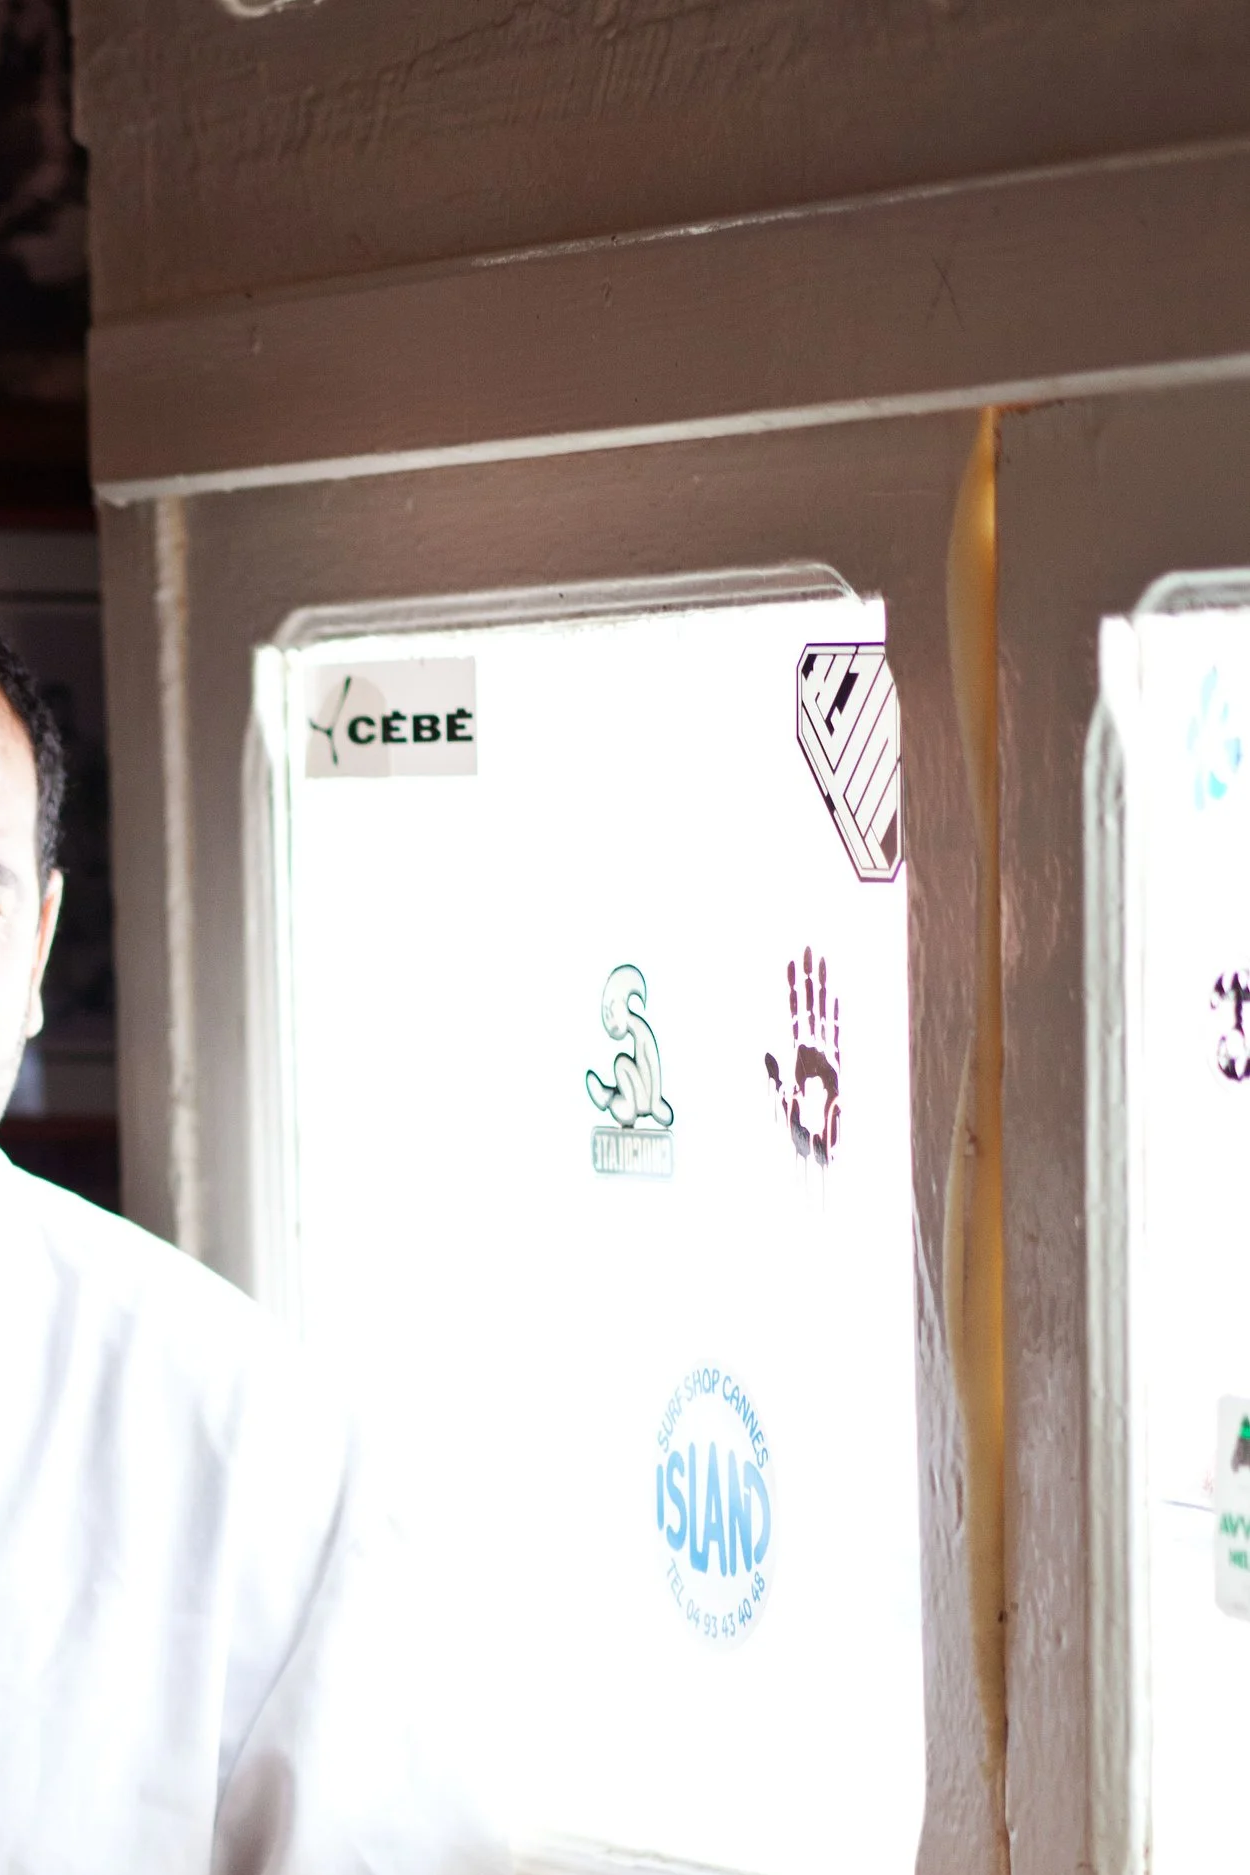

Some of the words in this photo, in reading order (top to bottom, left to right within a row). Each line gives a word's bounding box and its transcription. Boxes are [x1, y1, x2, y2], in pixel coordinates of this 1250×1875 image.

[658, 1387, 682, 1453] SURF
[684, 1368, 720, 1402] SHOP
[722, 1375, 769, 1470] CANNES
[656, 1441, 772, 1578] ISLAND
[666, 1557, 686, 1608] TEL
[686, 1598, 701, 1629] 04
[703, 1612, 718, 1640] 93
[720, 1611, 736, 1640] 43
[737, 1597, 753, 1629] 40
[750, 1570, 766, 1605] 48
